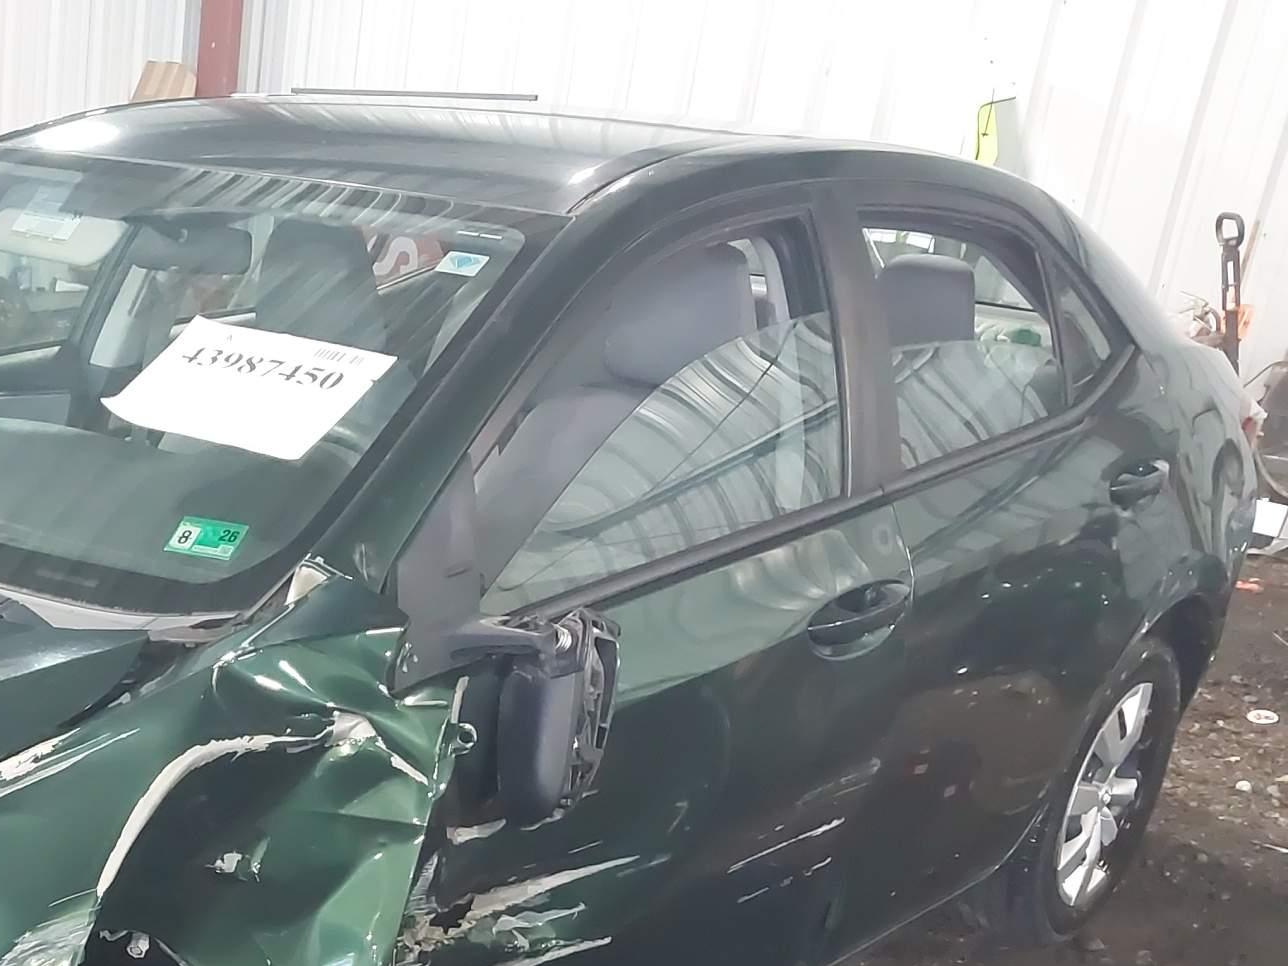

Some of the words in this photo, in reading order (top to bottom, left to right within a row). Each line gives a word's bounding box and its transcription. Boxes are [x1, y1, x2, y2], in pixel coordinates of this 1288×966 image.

[182, 347, 344, 389] 43987450
[178, 529, 192, 544] 8
[218, 529, 240, 543] 26
